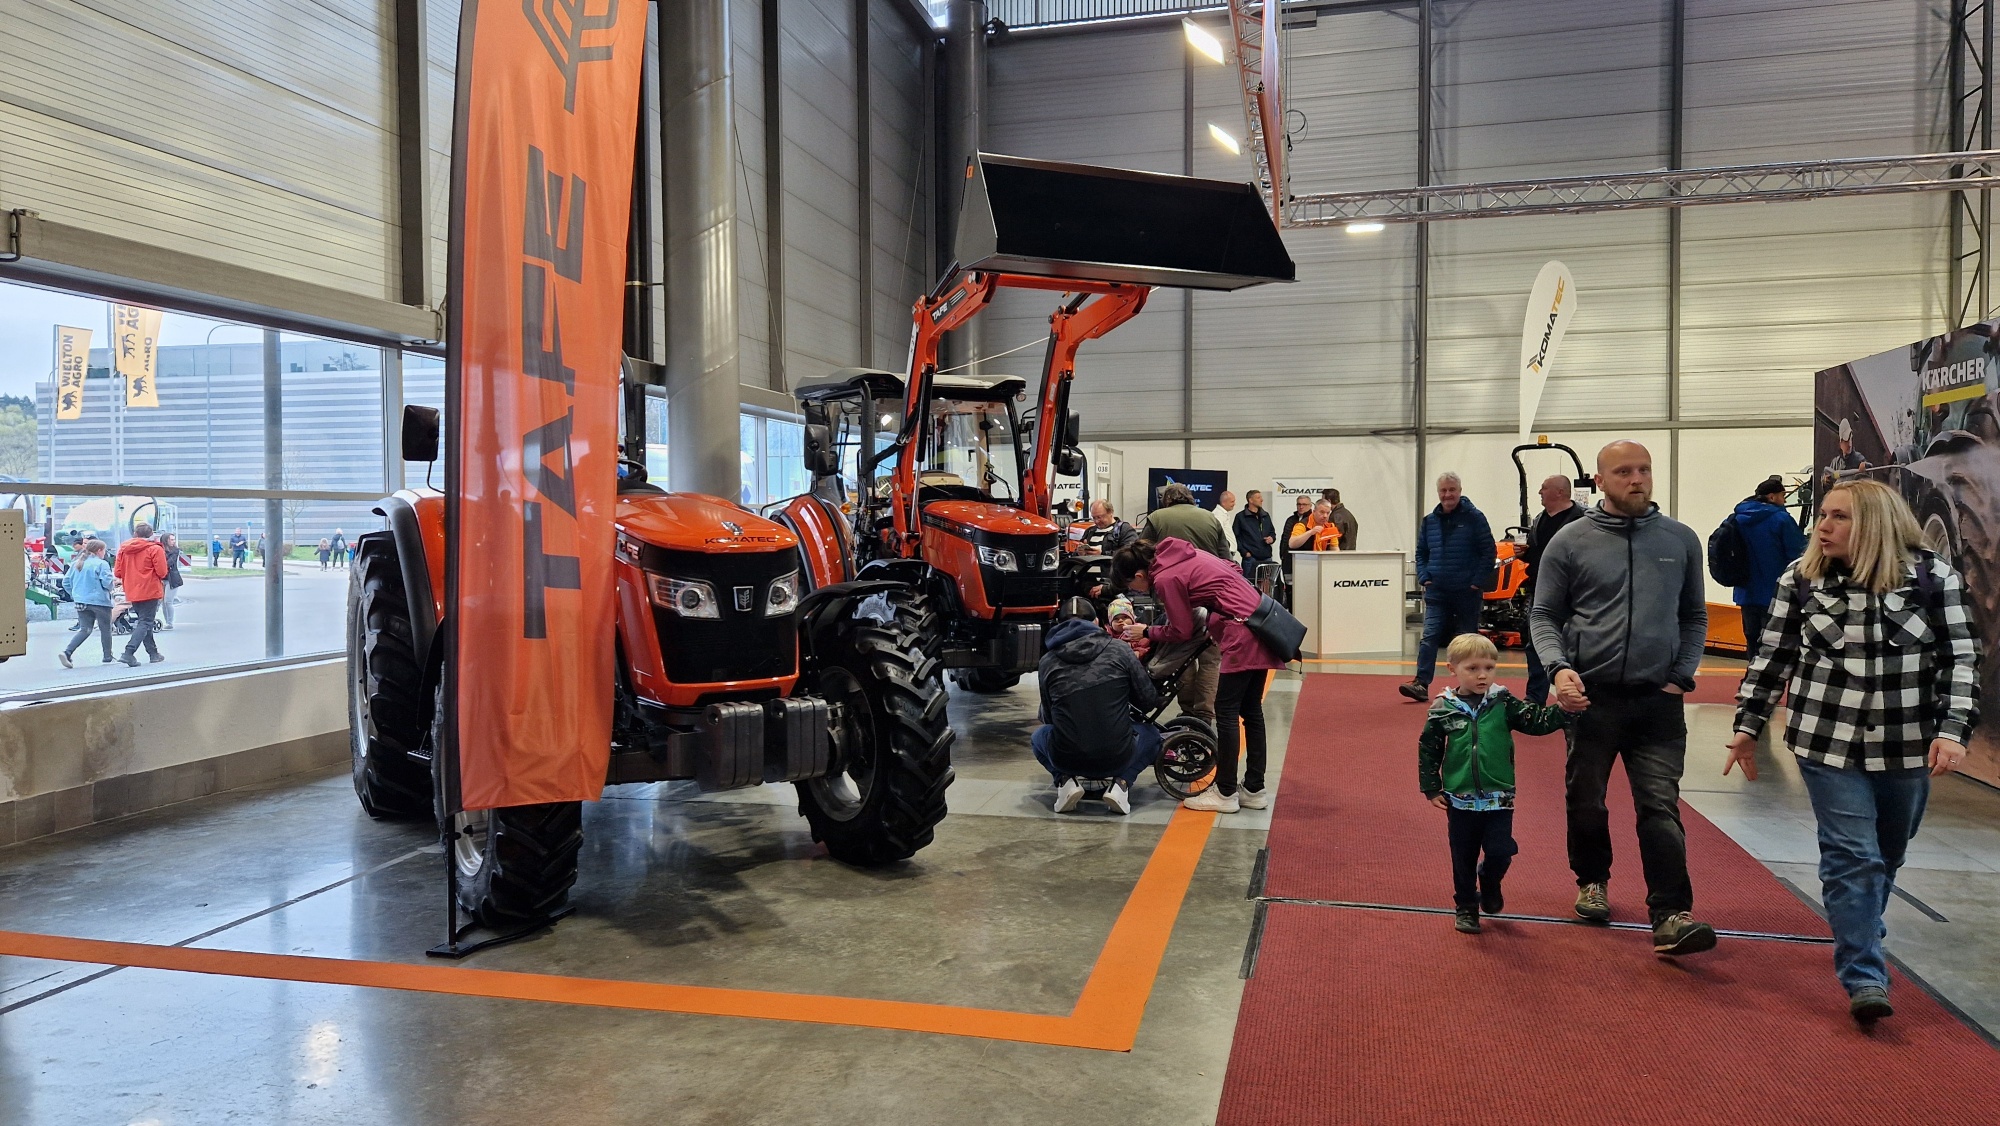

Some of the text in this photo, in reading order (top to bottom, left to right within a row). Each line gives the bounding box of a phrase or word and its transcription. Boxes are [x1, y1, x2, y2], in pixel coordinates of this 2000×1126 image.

[127, 307, 139, 330] AG
[932, 302, 948, 321] TAFE
[1537, 276, 1564, 367] KOMATEC
[62, 335, 73, 387] WIELTON
[72, 357, 83, 388] AGRO
[1922, 357, 1985, 391] KÄRCHER
[522, 144, 587, 640] TAFE
[704, 536, 777, 545] KOMATEC
[1333, 579, 1390, 588] KOMATEC
